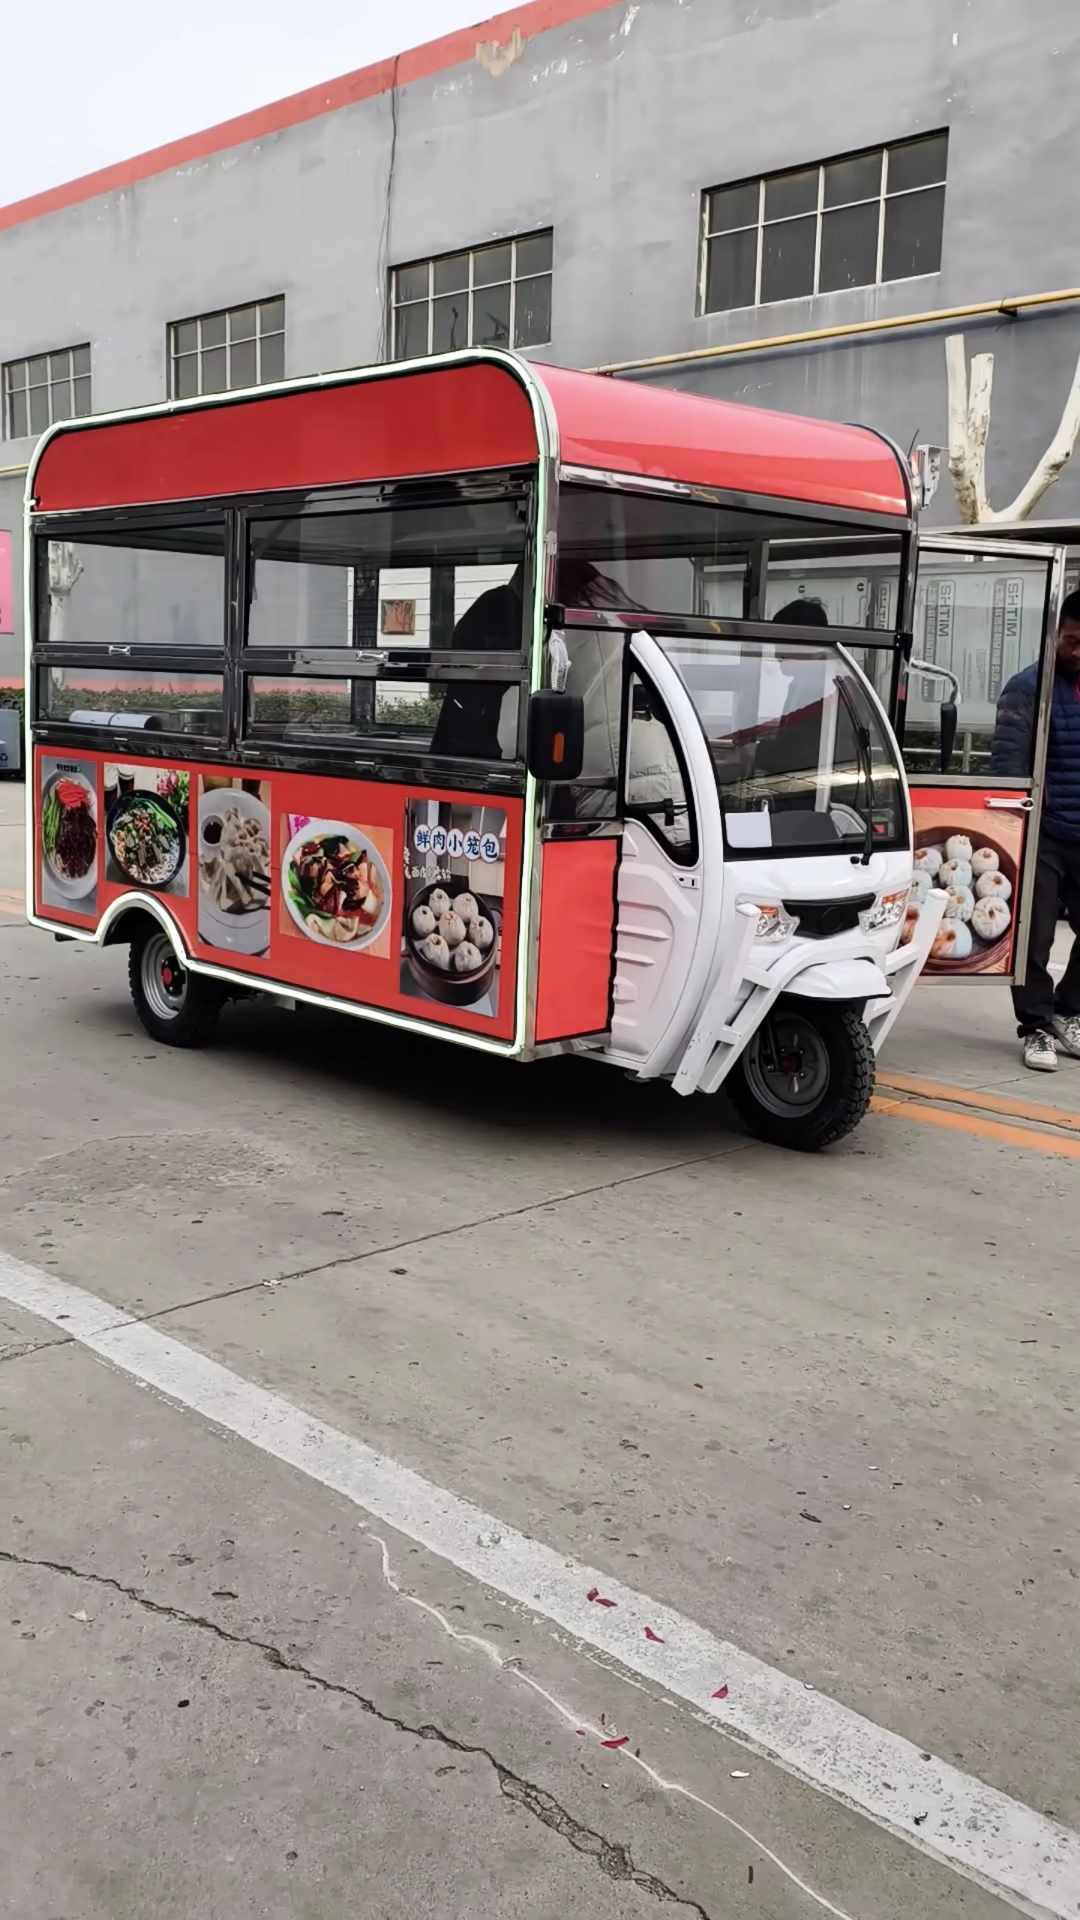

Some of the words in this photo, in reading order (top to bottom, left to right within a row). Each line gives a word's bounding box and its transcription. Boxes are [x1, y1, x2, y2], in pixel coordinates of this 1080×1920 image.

[416, 829, 498, 859] 鲜肉小笼包
